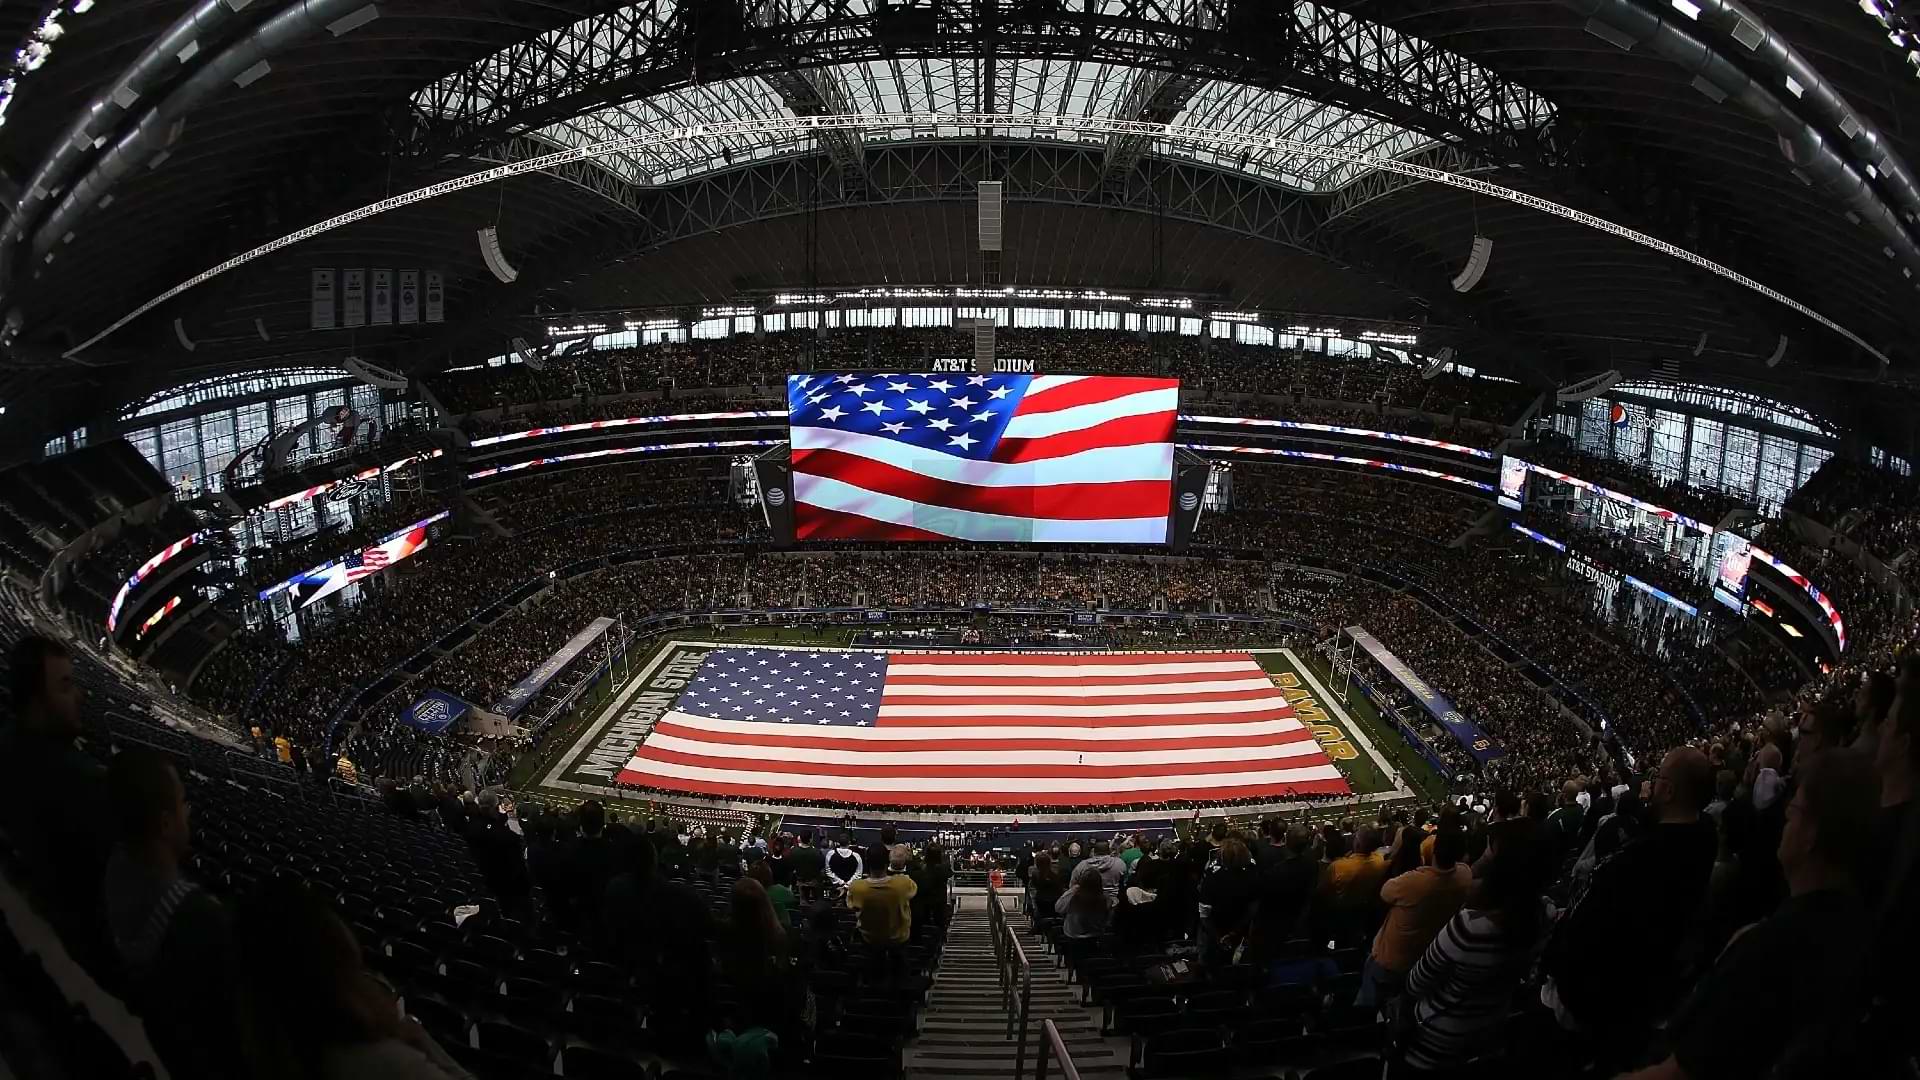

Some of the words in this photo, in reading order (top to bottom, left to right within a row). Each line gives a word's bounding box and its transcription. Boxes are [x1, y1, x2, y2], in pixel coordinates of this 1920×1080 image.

[932, 358, 968, 373] AT&T
[970, 358, 1035, 373] SDIUM
[1566, 557, 1586, 575] AT&T
[1585, 565, 1621, 593] STADIUM
[574, 690, 679, 778] MICHIGAN
[650, 650, 710, 690] STATE
